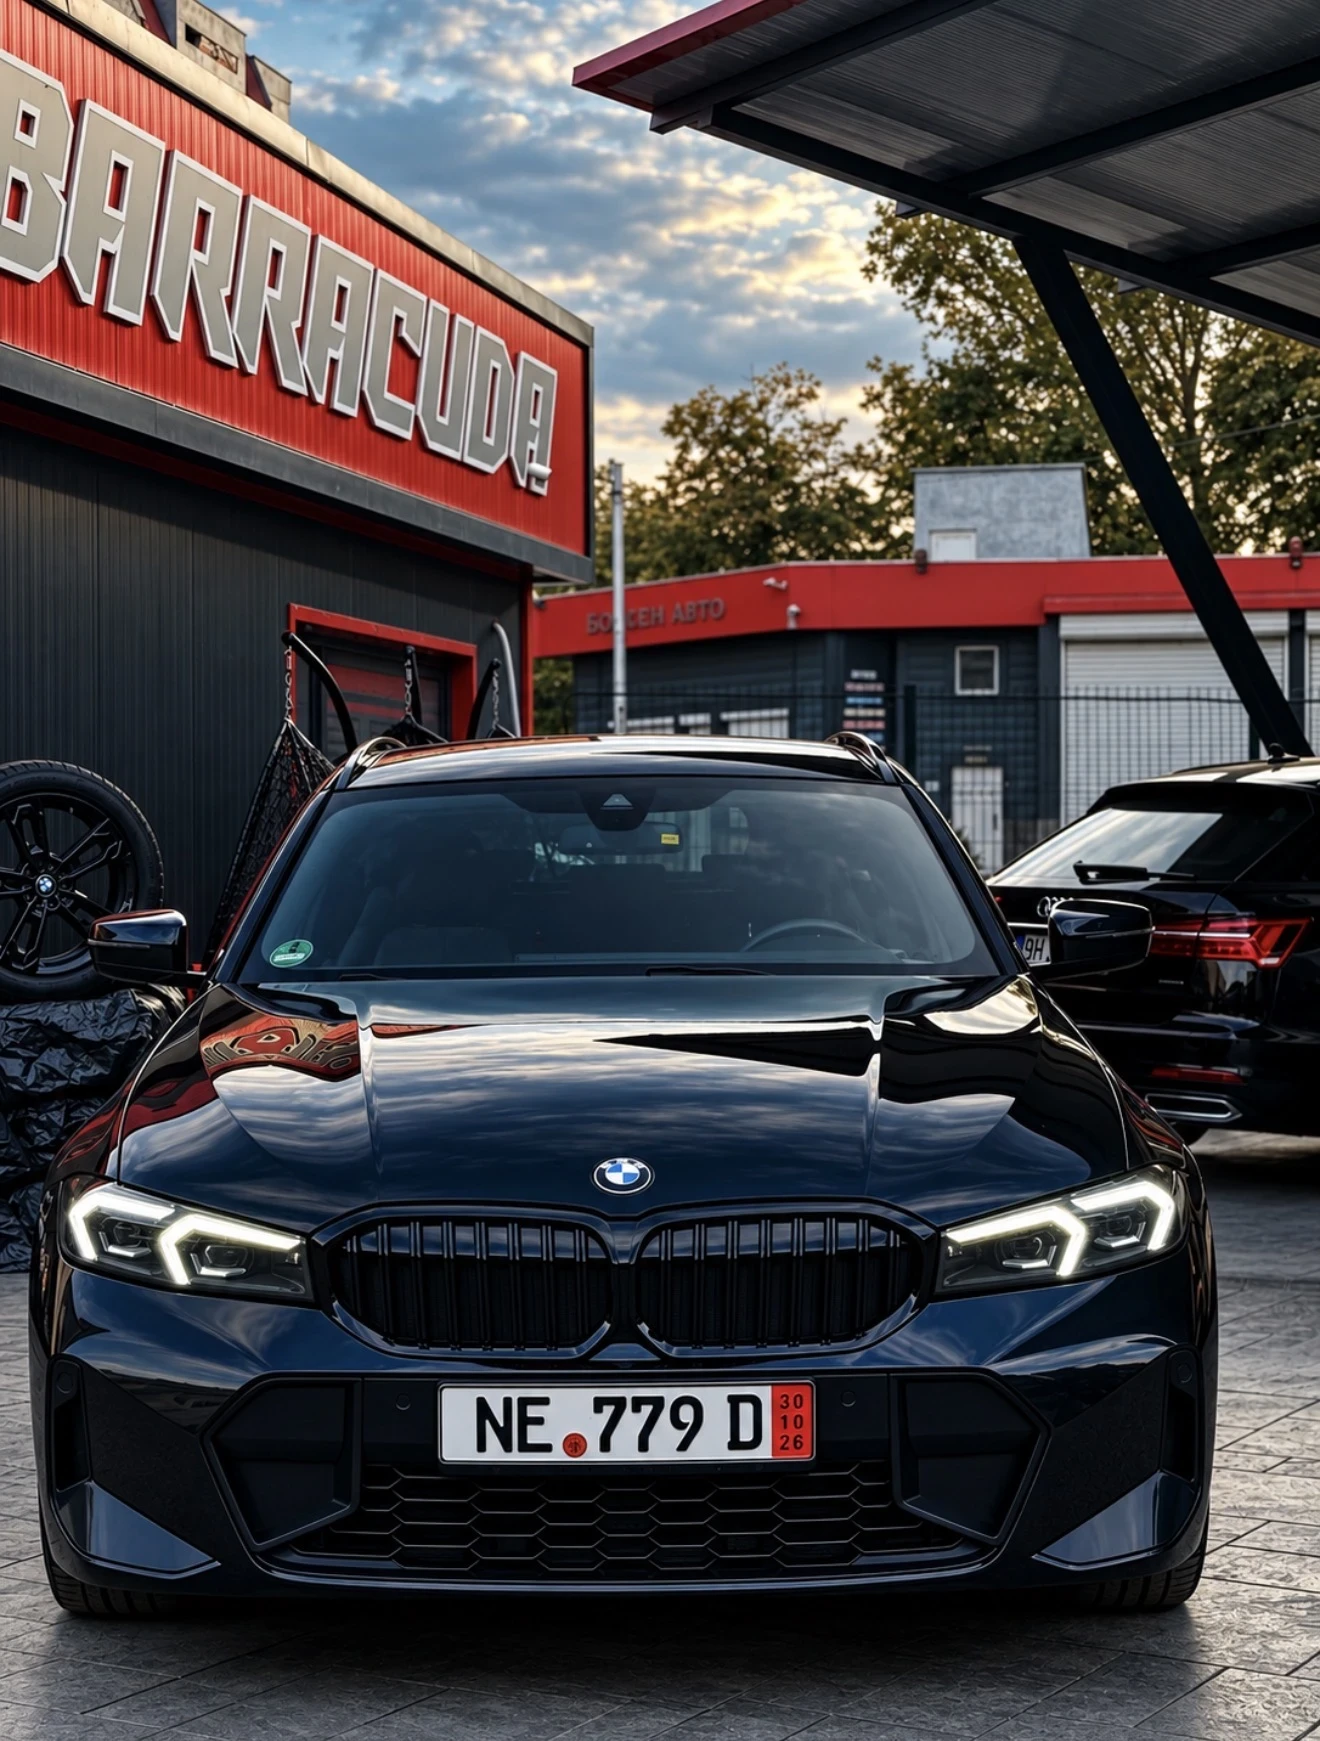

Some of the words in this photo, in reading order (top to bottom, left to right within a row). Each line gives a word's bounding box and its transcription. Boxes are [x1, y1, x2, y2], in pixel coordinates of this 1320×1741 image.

[0, 49, 558, 497] BARRACUDA
[672, 596, 725, 624] АВТО
[1025, 937, 1050, 961] 9H
[780, 1393, 804, 1410] 30
[475, 1396, 553, 1453] NE
[593, 1394, 704, 1453] 779
[727, 1393, 763, 1451] D
[780, 1414, 804, 1430] 10
[779, 1434, 804, 1451] 26
